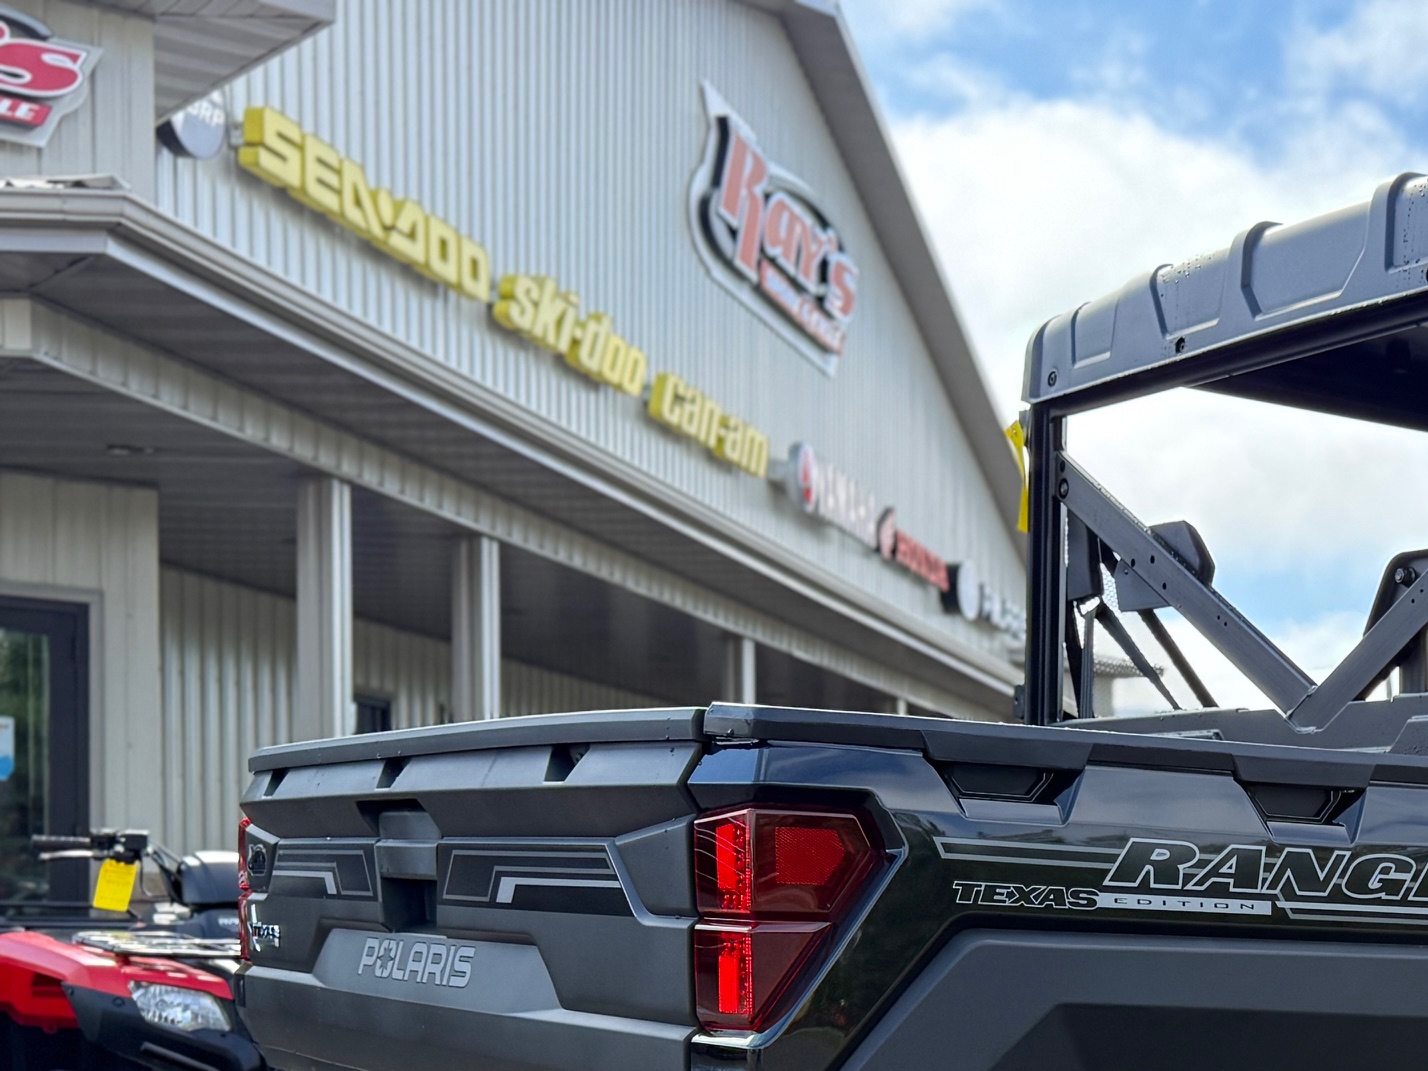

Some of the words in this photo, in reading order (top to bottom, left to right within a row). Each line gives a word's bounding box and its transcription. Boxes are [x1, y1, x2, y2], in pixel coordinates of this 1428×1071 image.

[952, 880, 1101, 911] TEXAS
[1113, 897, 1255, 910] EDITION
[357, 936, 477, 988] POLARIS
